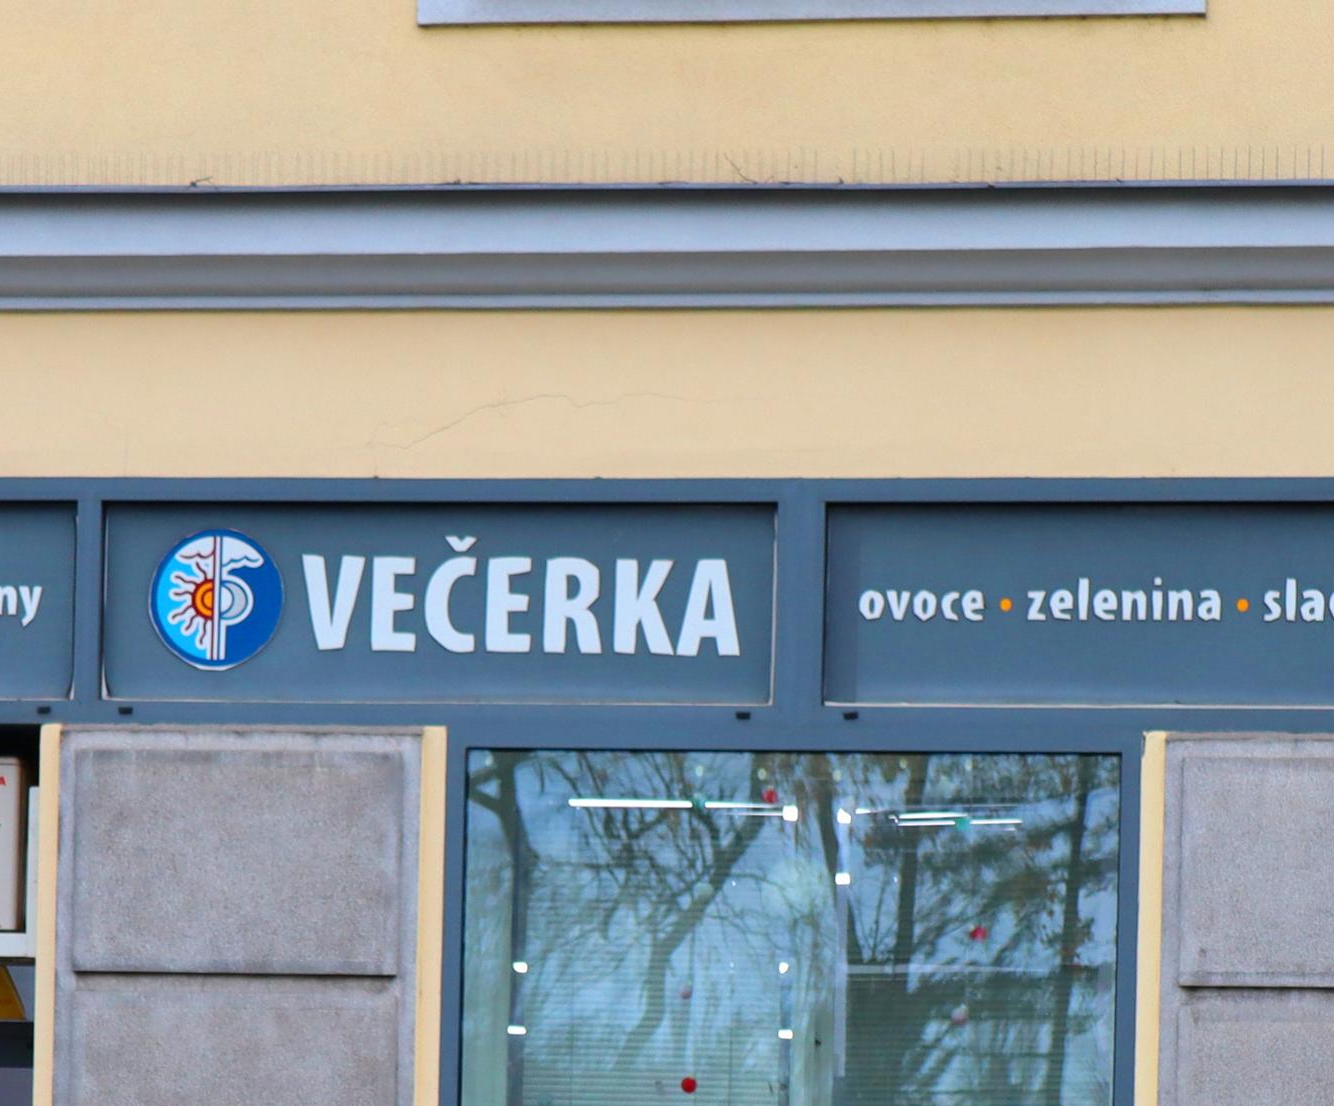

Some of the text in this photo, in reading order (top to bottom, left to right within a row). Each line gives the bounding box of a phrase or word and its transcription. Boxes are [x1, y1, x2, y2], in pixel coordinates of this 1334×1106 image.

[301, 535, 741, 657] VEČERKA
[858, 588, 985, 622] ovoce
[1027, 576, 1223, 622] zelenina
